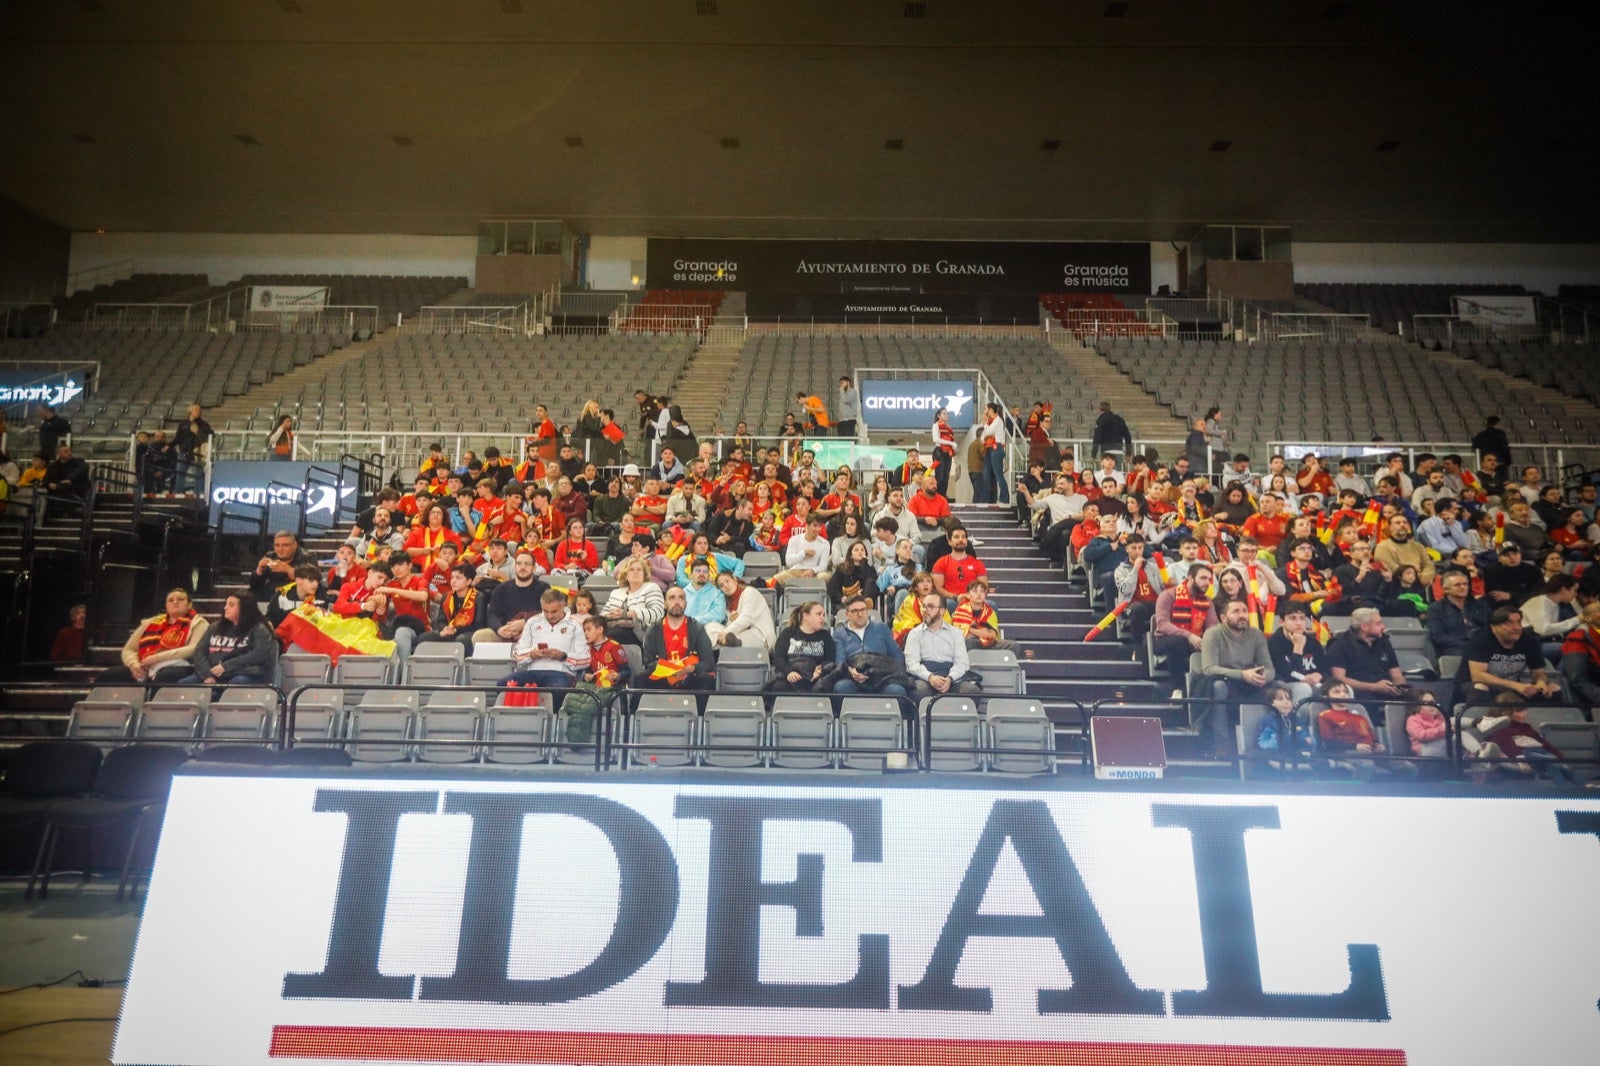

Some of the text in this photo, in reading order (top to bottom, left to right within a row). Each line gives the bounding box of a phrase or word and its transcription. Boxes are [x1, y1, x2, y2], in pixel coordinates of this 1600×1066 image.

[673, 259, 738, 271] Granada
[796, 260, 1005, 275] AYUNTAMIENTO DE GRANADA
[1063, 264, 1129, 276] Granada
[673, 272, 737, 283] es deporte
[1064, 274, 1129, 287] es música
[865, 393, 942, 409] aramark
[1139, 583, 1150, 596] 15
[1116, 770, 1156, 779] MONDO
[282, 790, 1392, 1022] IDEAL
